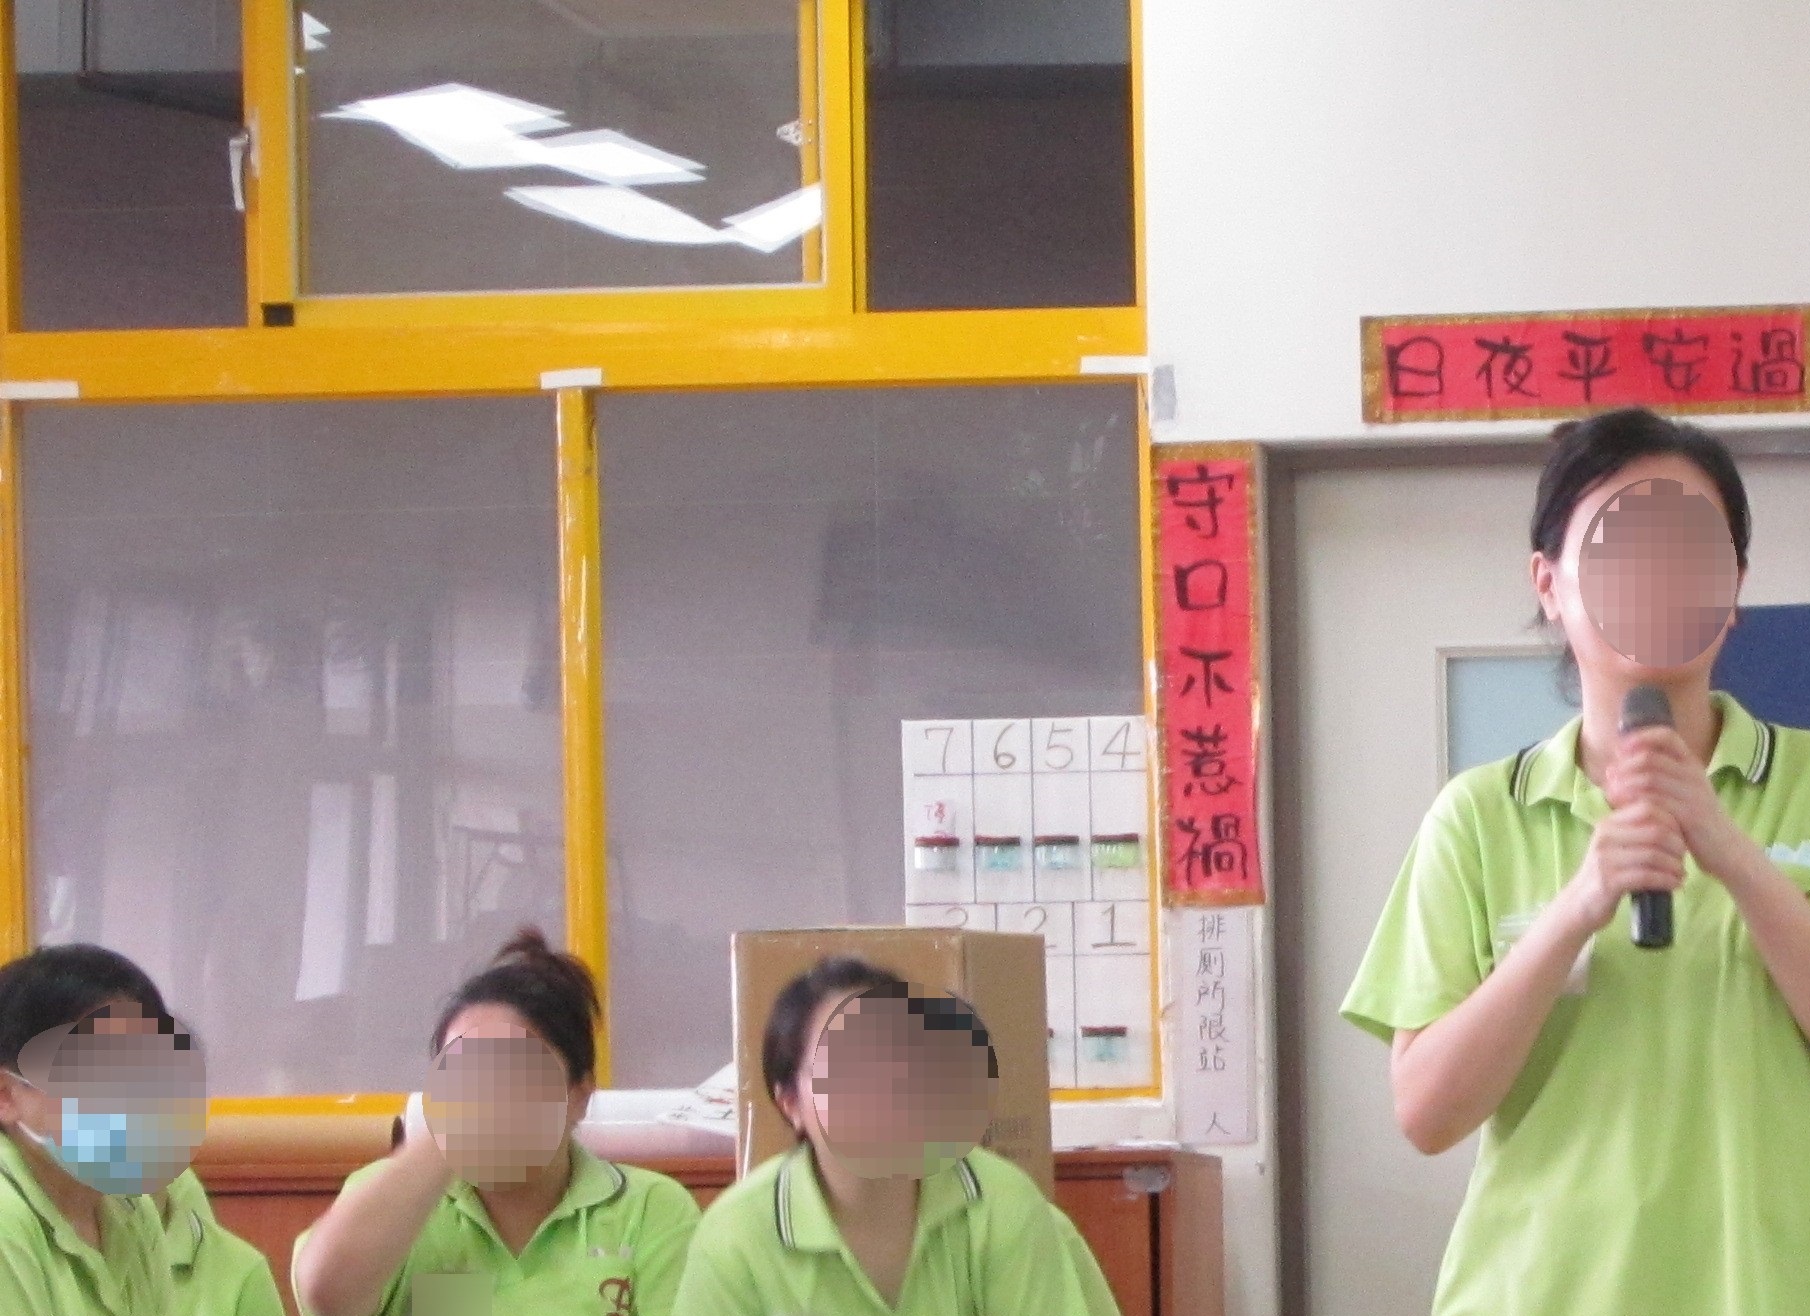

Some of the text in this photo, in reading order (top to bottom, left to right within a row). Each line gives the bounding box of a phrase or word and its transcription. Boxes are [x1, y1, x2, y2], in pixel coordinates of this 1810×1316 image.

[1385, 327, 1805, 403] 日夜平安過
[1166, 464, 1249, 886] 守口不惹禍
[924, 721, 1141, 774] 7 6 5 4
[1091, 904, 1137, 949] 1
